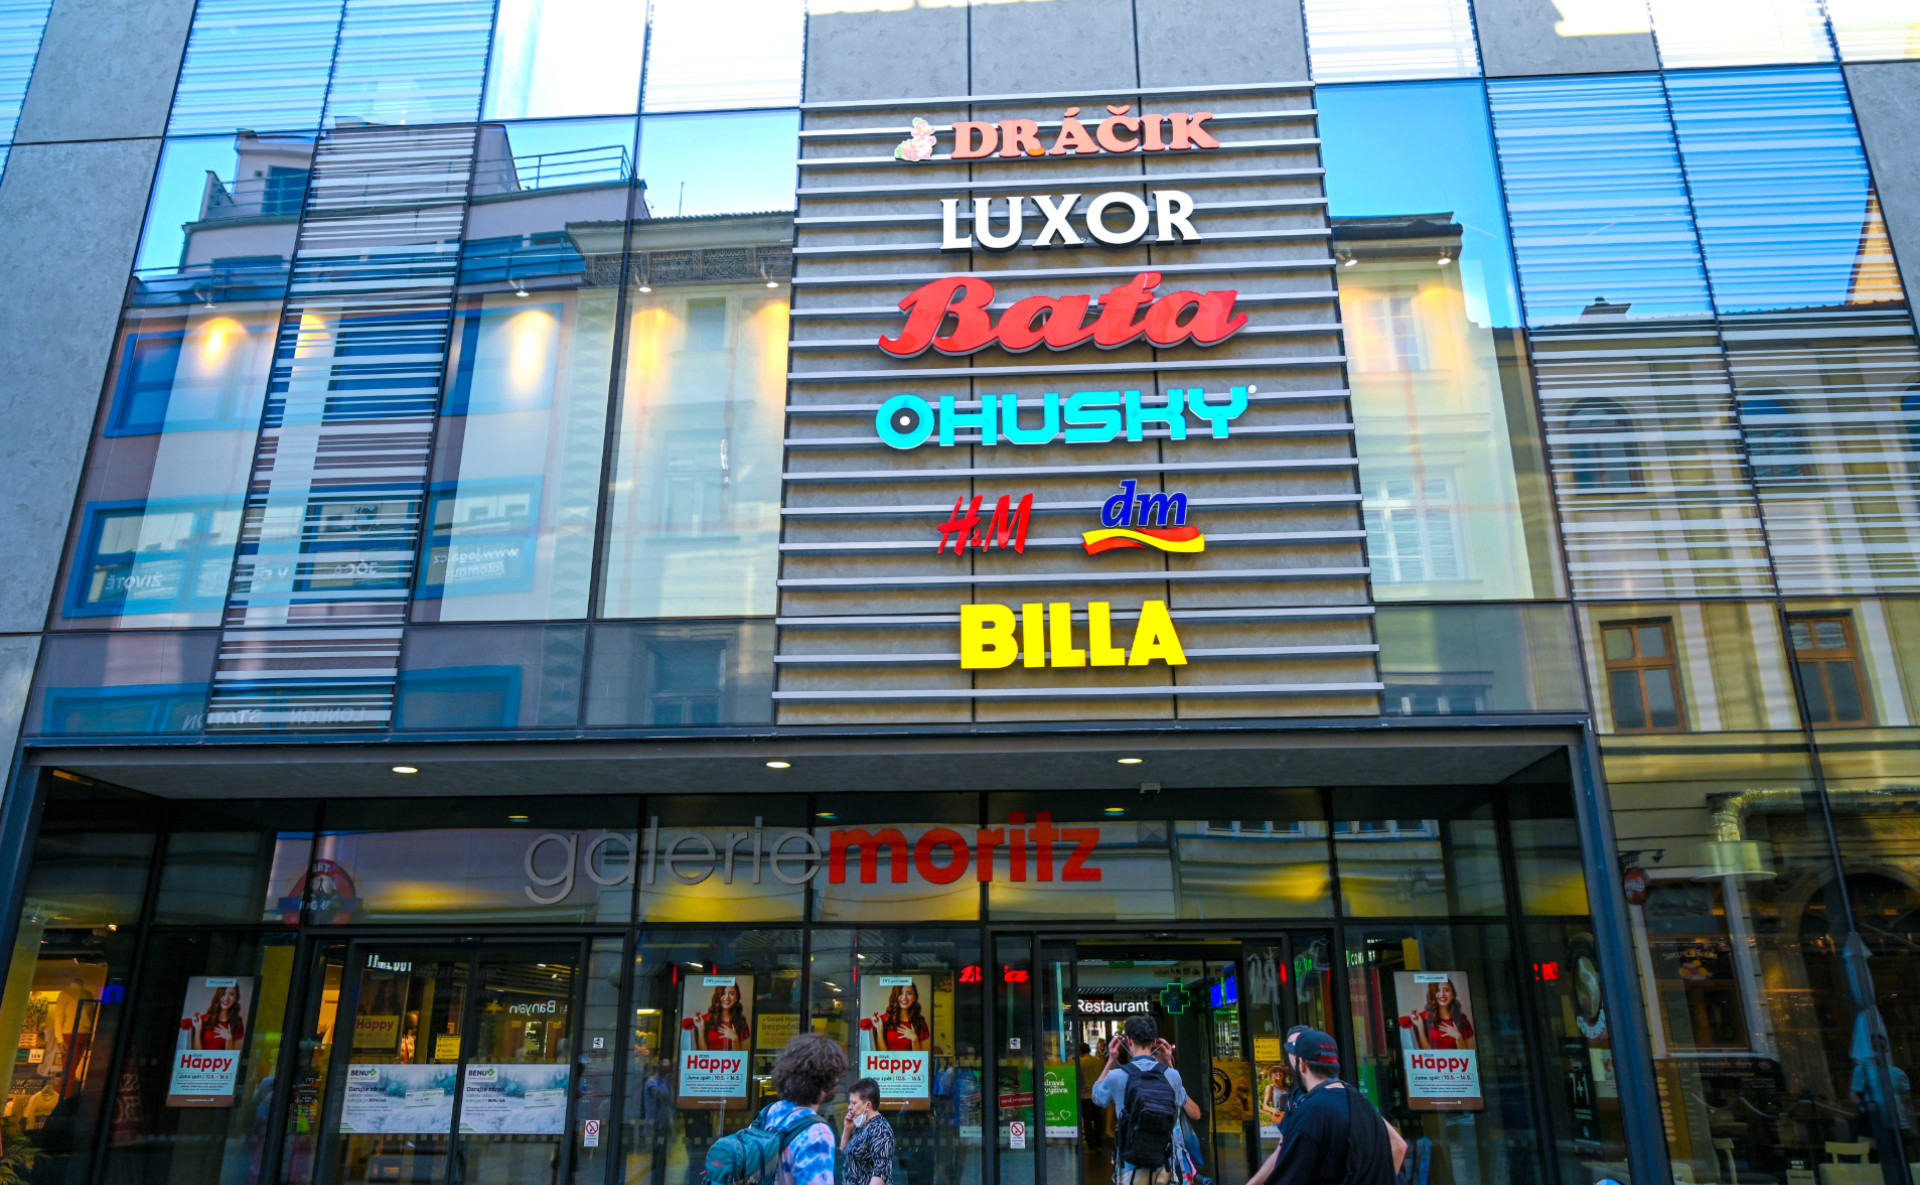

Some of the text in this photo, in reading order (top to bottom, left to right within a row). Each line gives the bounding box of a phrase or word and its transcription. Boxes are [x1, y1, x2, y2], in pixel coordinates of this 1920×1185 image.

[951, 104, 1220, 160] DRÁČIK
[940, 190, 1203, 253] LUXOR
[1100, 479, 1188, 529] dm
[936, 493, 1034, 556] H&M
[960, 600, 1188, 670] BILLA
[1077, 999, 1149, 1013] Restaurant
[356, 1018, 394, 1032] Happy
[180, 1054, 233, 1073] Happy
[468, 1069, 487, 1077] BENU
[687, 1054, 742, 1074] Happy
[867, 1055, 922, 1074] Happy
[1411, 1053, 1470, 1073] Happy
